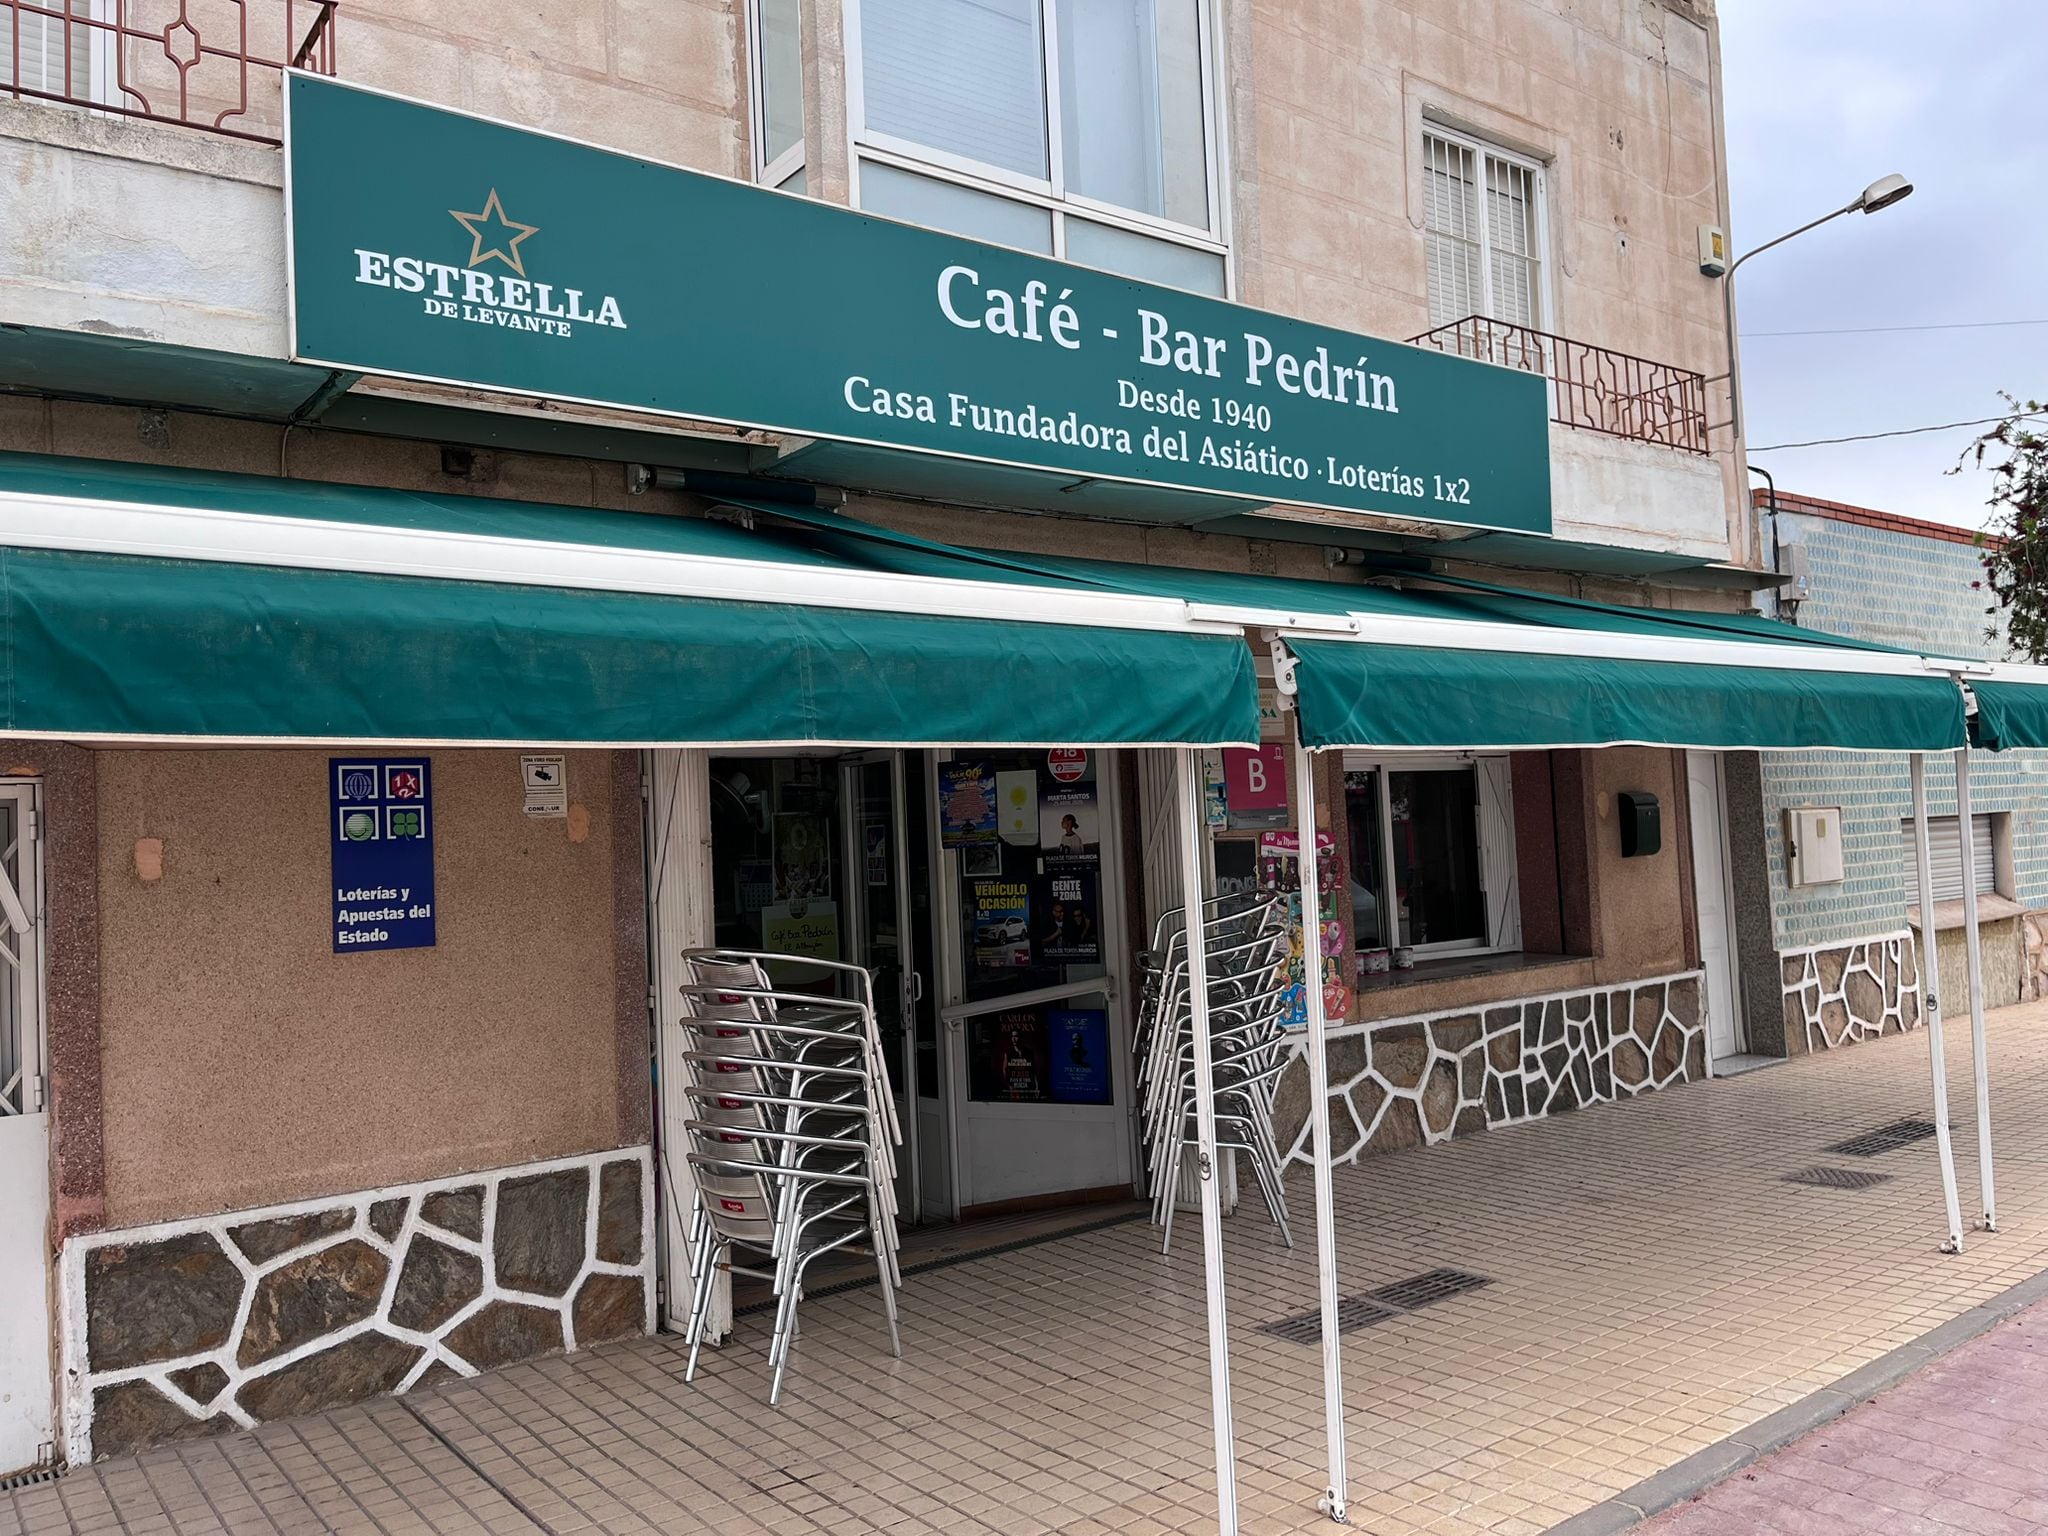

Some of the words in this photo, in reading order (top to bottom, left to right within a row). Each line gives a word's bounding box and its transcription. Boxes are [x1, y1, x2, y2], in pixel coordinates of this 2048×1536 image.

[354, 249, 627, 329] ESTRELLA
[424, 298, 458, 319] DE
[463, 304, 571, 338] LEVANTE
[937, 265, 1081, 350] Café
[1137, 308, 1227, 379] Bar
[1243, 332, 1399, 413] Pedrín
[1117, 379, 1201, 420] Desde
[1211, 397, 1272, 433] 1940
[843, 375, 937, 424] Casa
[948, 392, 1133, 455] Fundadora
[1143, 426, 1190, 463] del
[1198, 434, 1310, 481] Asiático
[1326, 456, 1425, 498] Loterías
[1433, 474, 1471, 505] 1x2
[1248, 758, 1267, 793] B
[1047, 794, 1067, 802] MARTA
[1067, 792, 1090, 801] SANTOS
[338, 886, 397, 902] Loterías
[401, 888, 410, 902] y
[975, 882, 1028, 896] VEHÍCULO
[1052, 880, 1081, 892] GENTE
[979, 895, 1026, 910] OCASIÓN
[1059, 891, 1082, 901] ZONA
[338, 907, 405, 926] Apuestas
[409, 905, 431, 919] del
[338, 928, 389, 945] Estado
